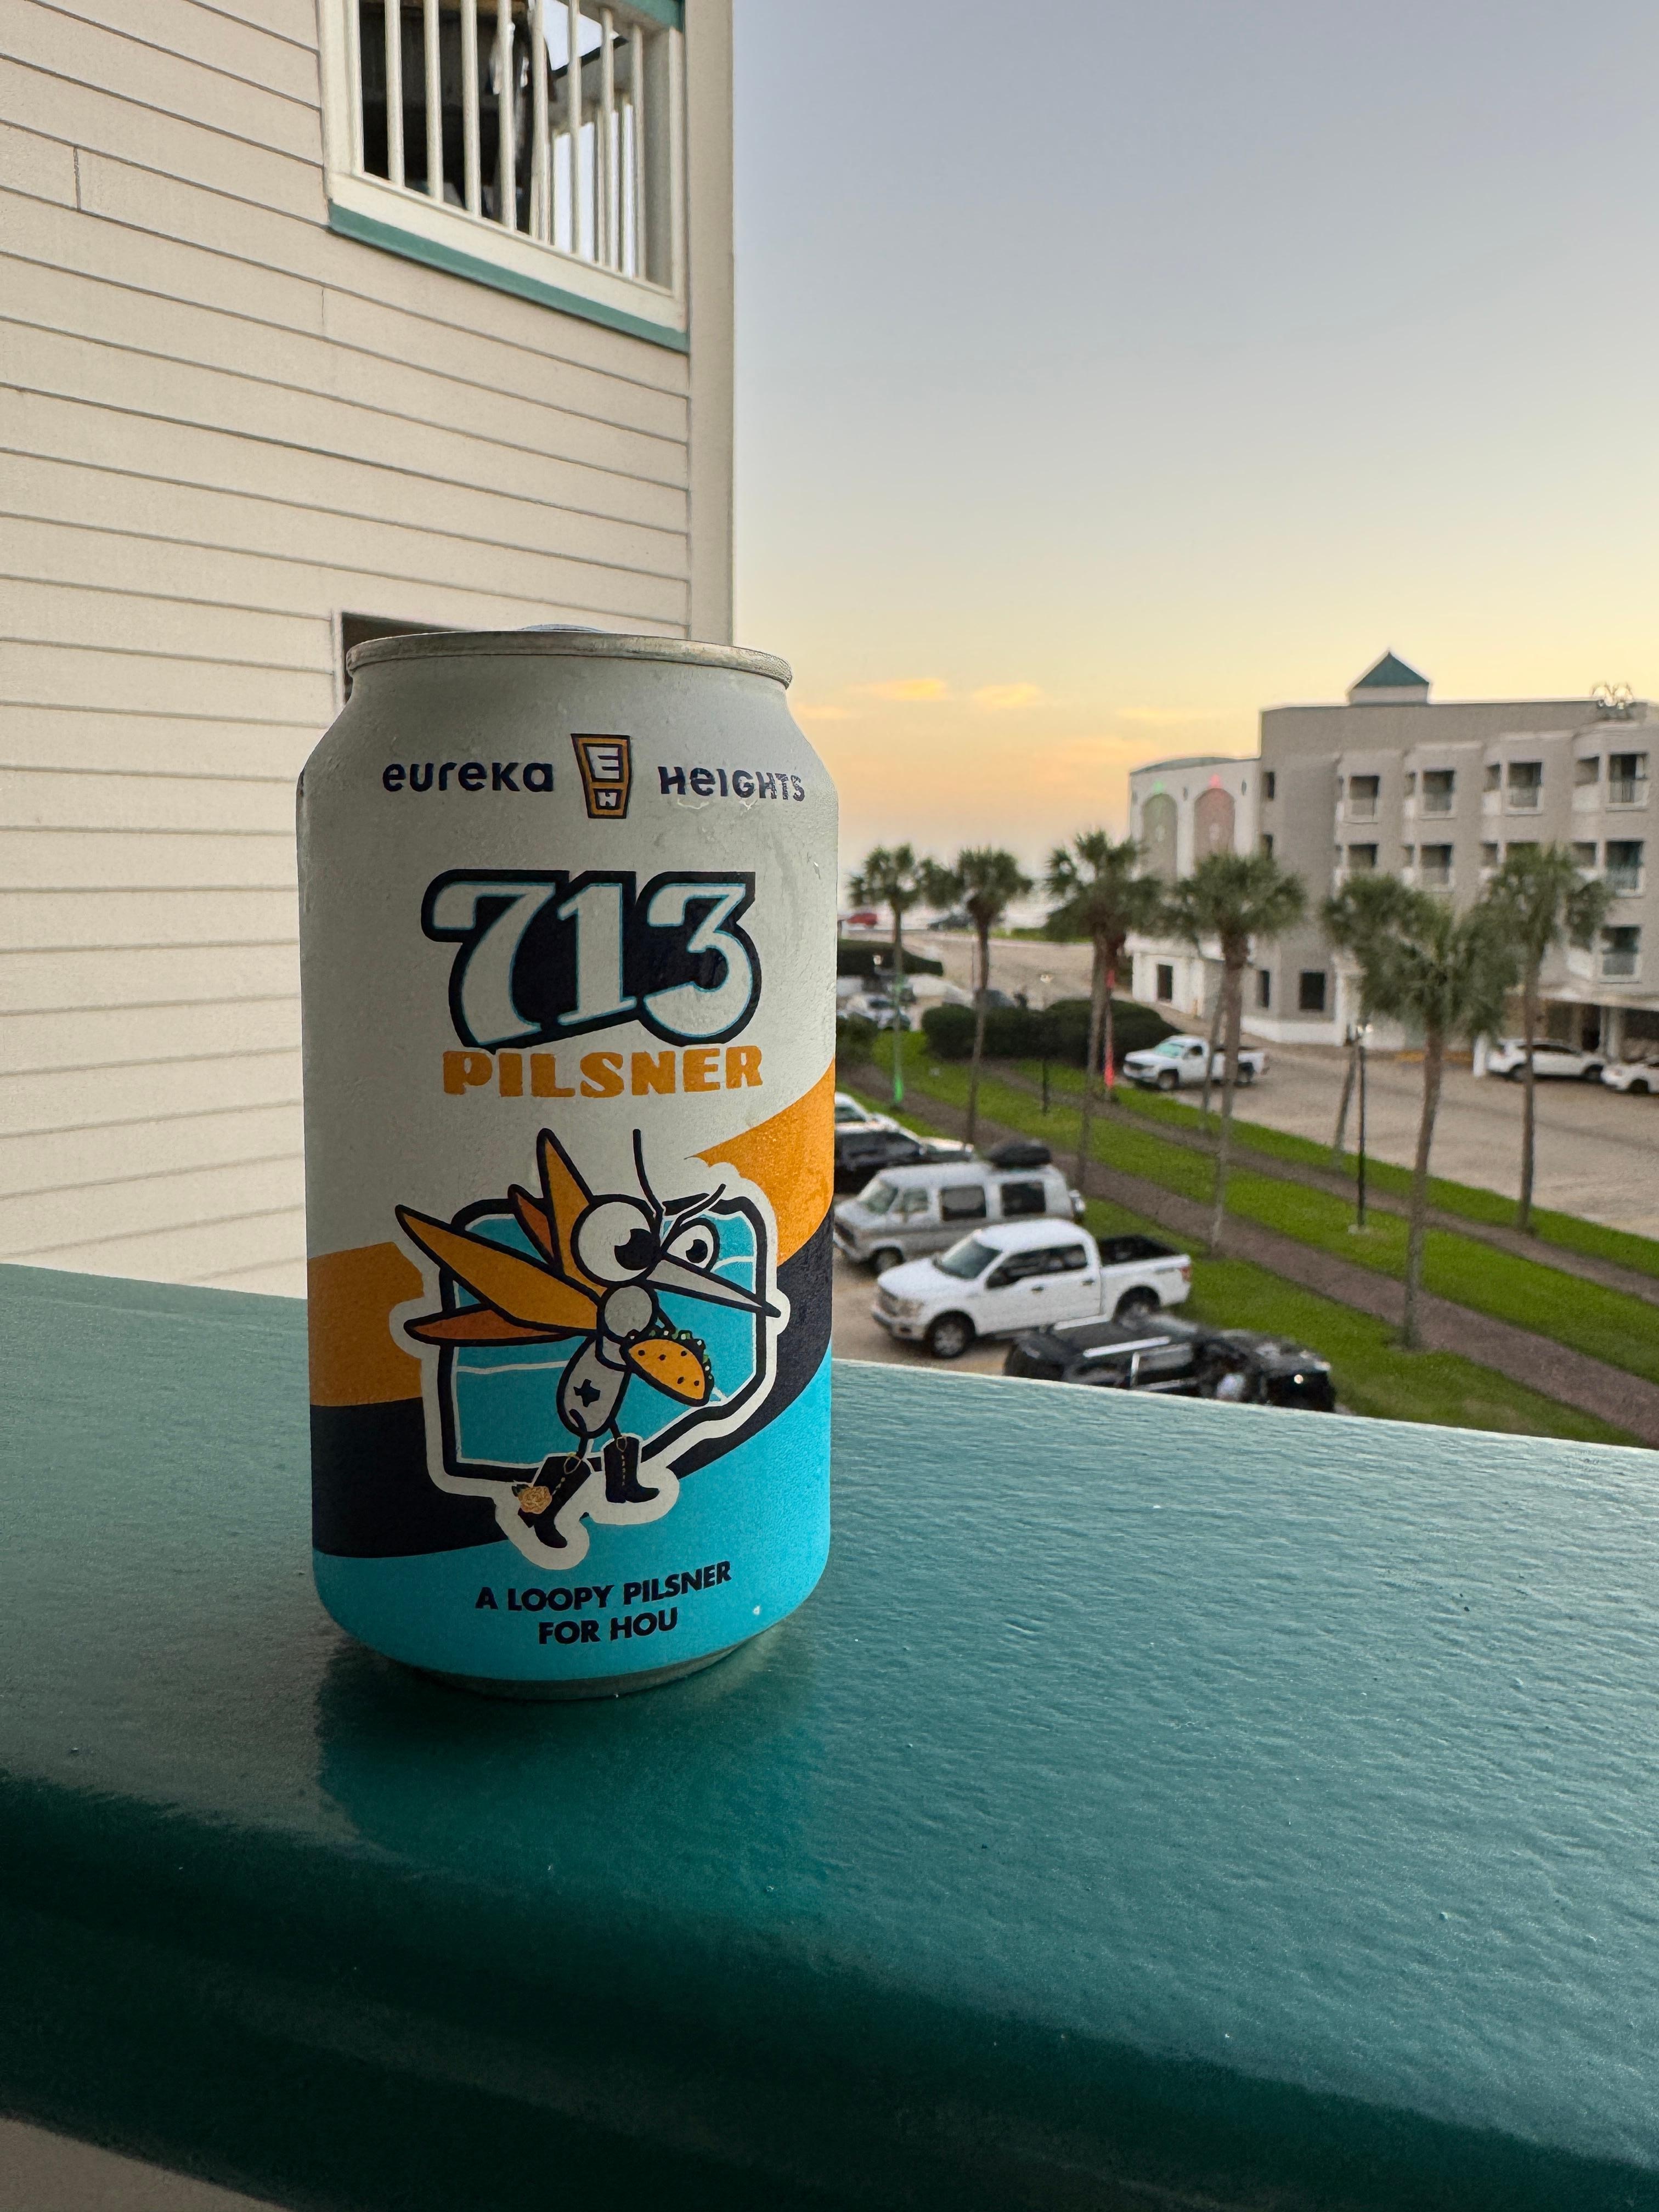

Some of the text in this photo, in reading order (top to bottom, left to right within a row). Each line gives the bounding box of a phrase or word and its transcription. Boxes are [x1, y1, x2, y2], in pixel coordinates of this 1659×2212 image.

[427, 874, 758, 1048] 713
[443, 1046, 763, 1098] PILSNER
[475, 1560, 732, 1612] A LOOPY PILSNER
[538, 1607, 678, 1645] FOR HOU
